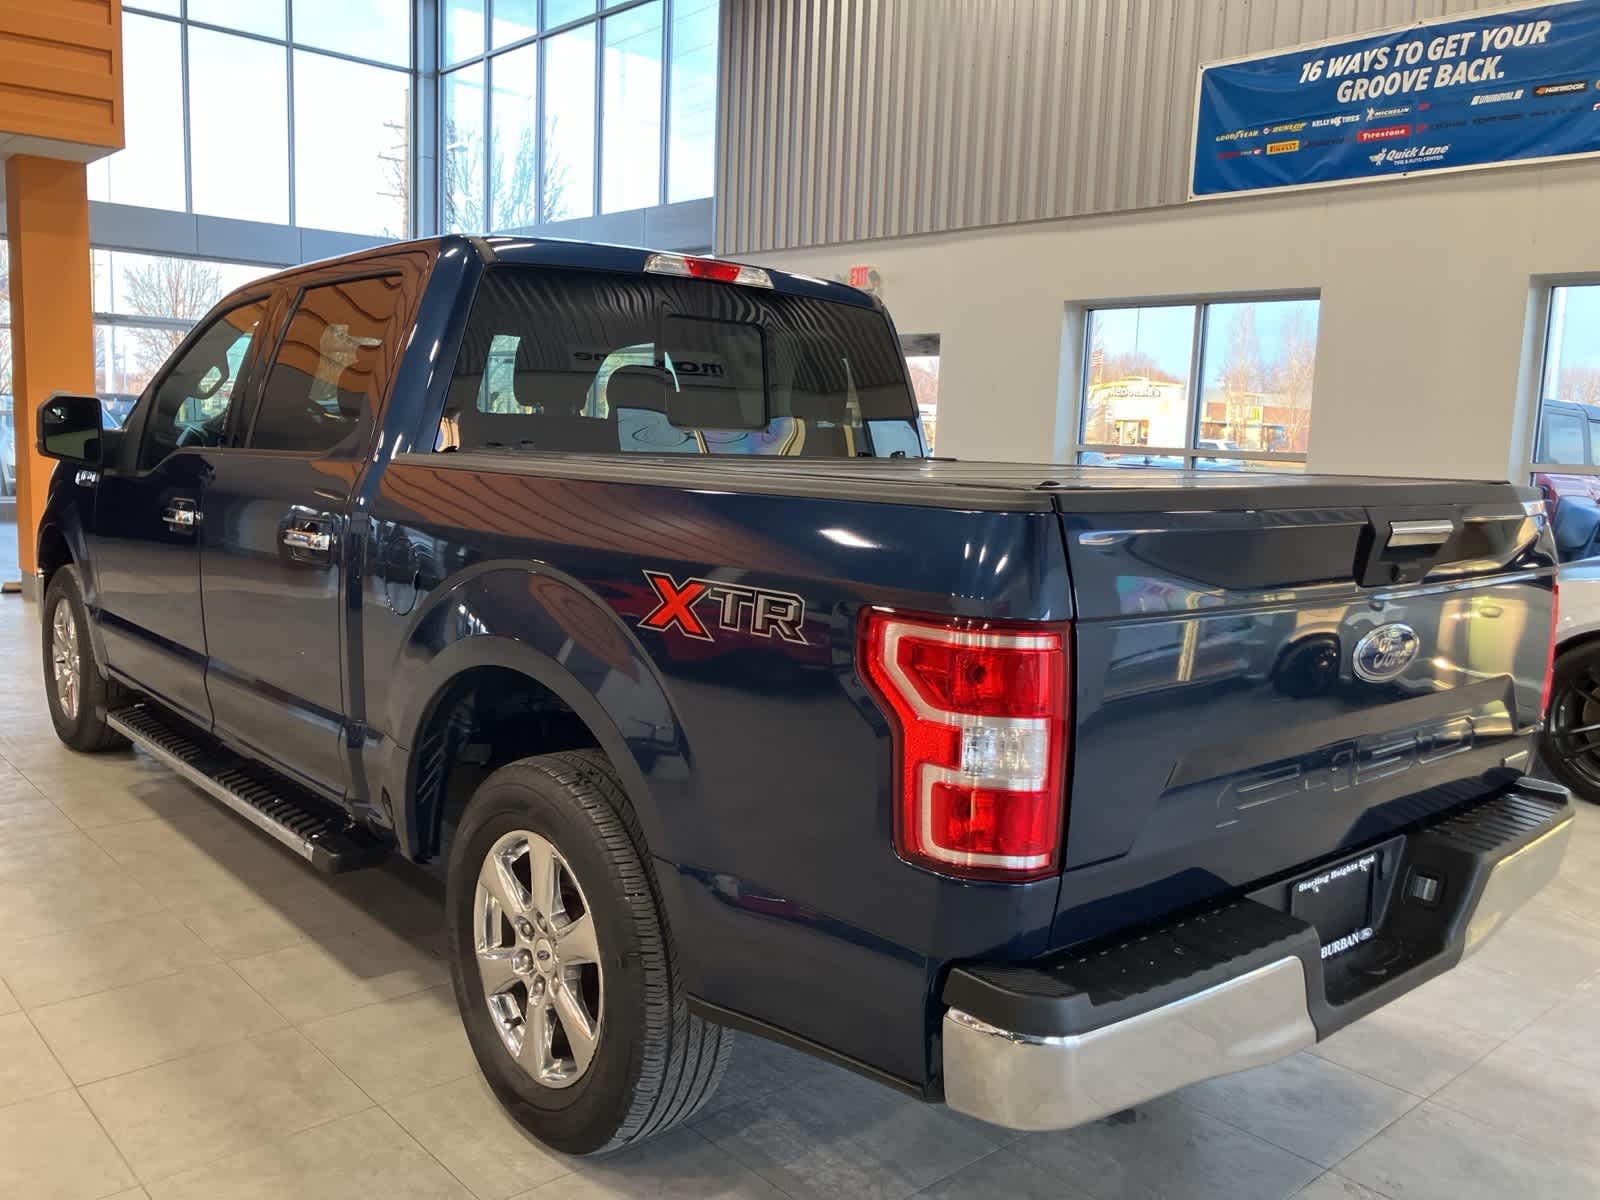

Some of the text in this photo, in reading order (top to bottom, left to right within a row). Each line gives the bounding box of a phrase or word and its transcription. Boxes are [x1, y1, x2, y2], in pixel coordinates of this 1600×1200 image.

[1299, 20, 1551, 83] 16 WAYS TO GET YOUR
[1336, 56, 1505, 103] GROOVE BACK.
[1215, 129, 1259, 142] GOODYEAR
[1386, 144, 1448, 160] Quick Lane
[851, 267, 868, 286] EXIT
[637, 569, 810, 645] XTR
